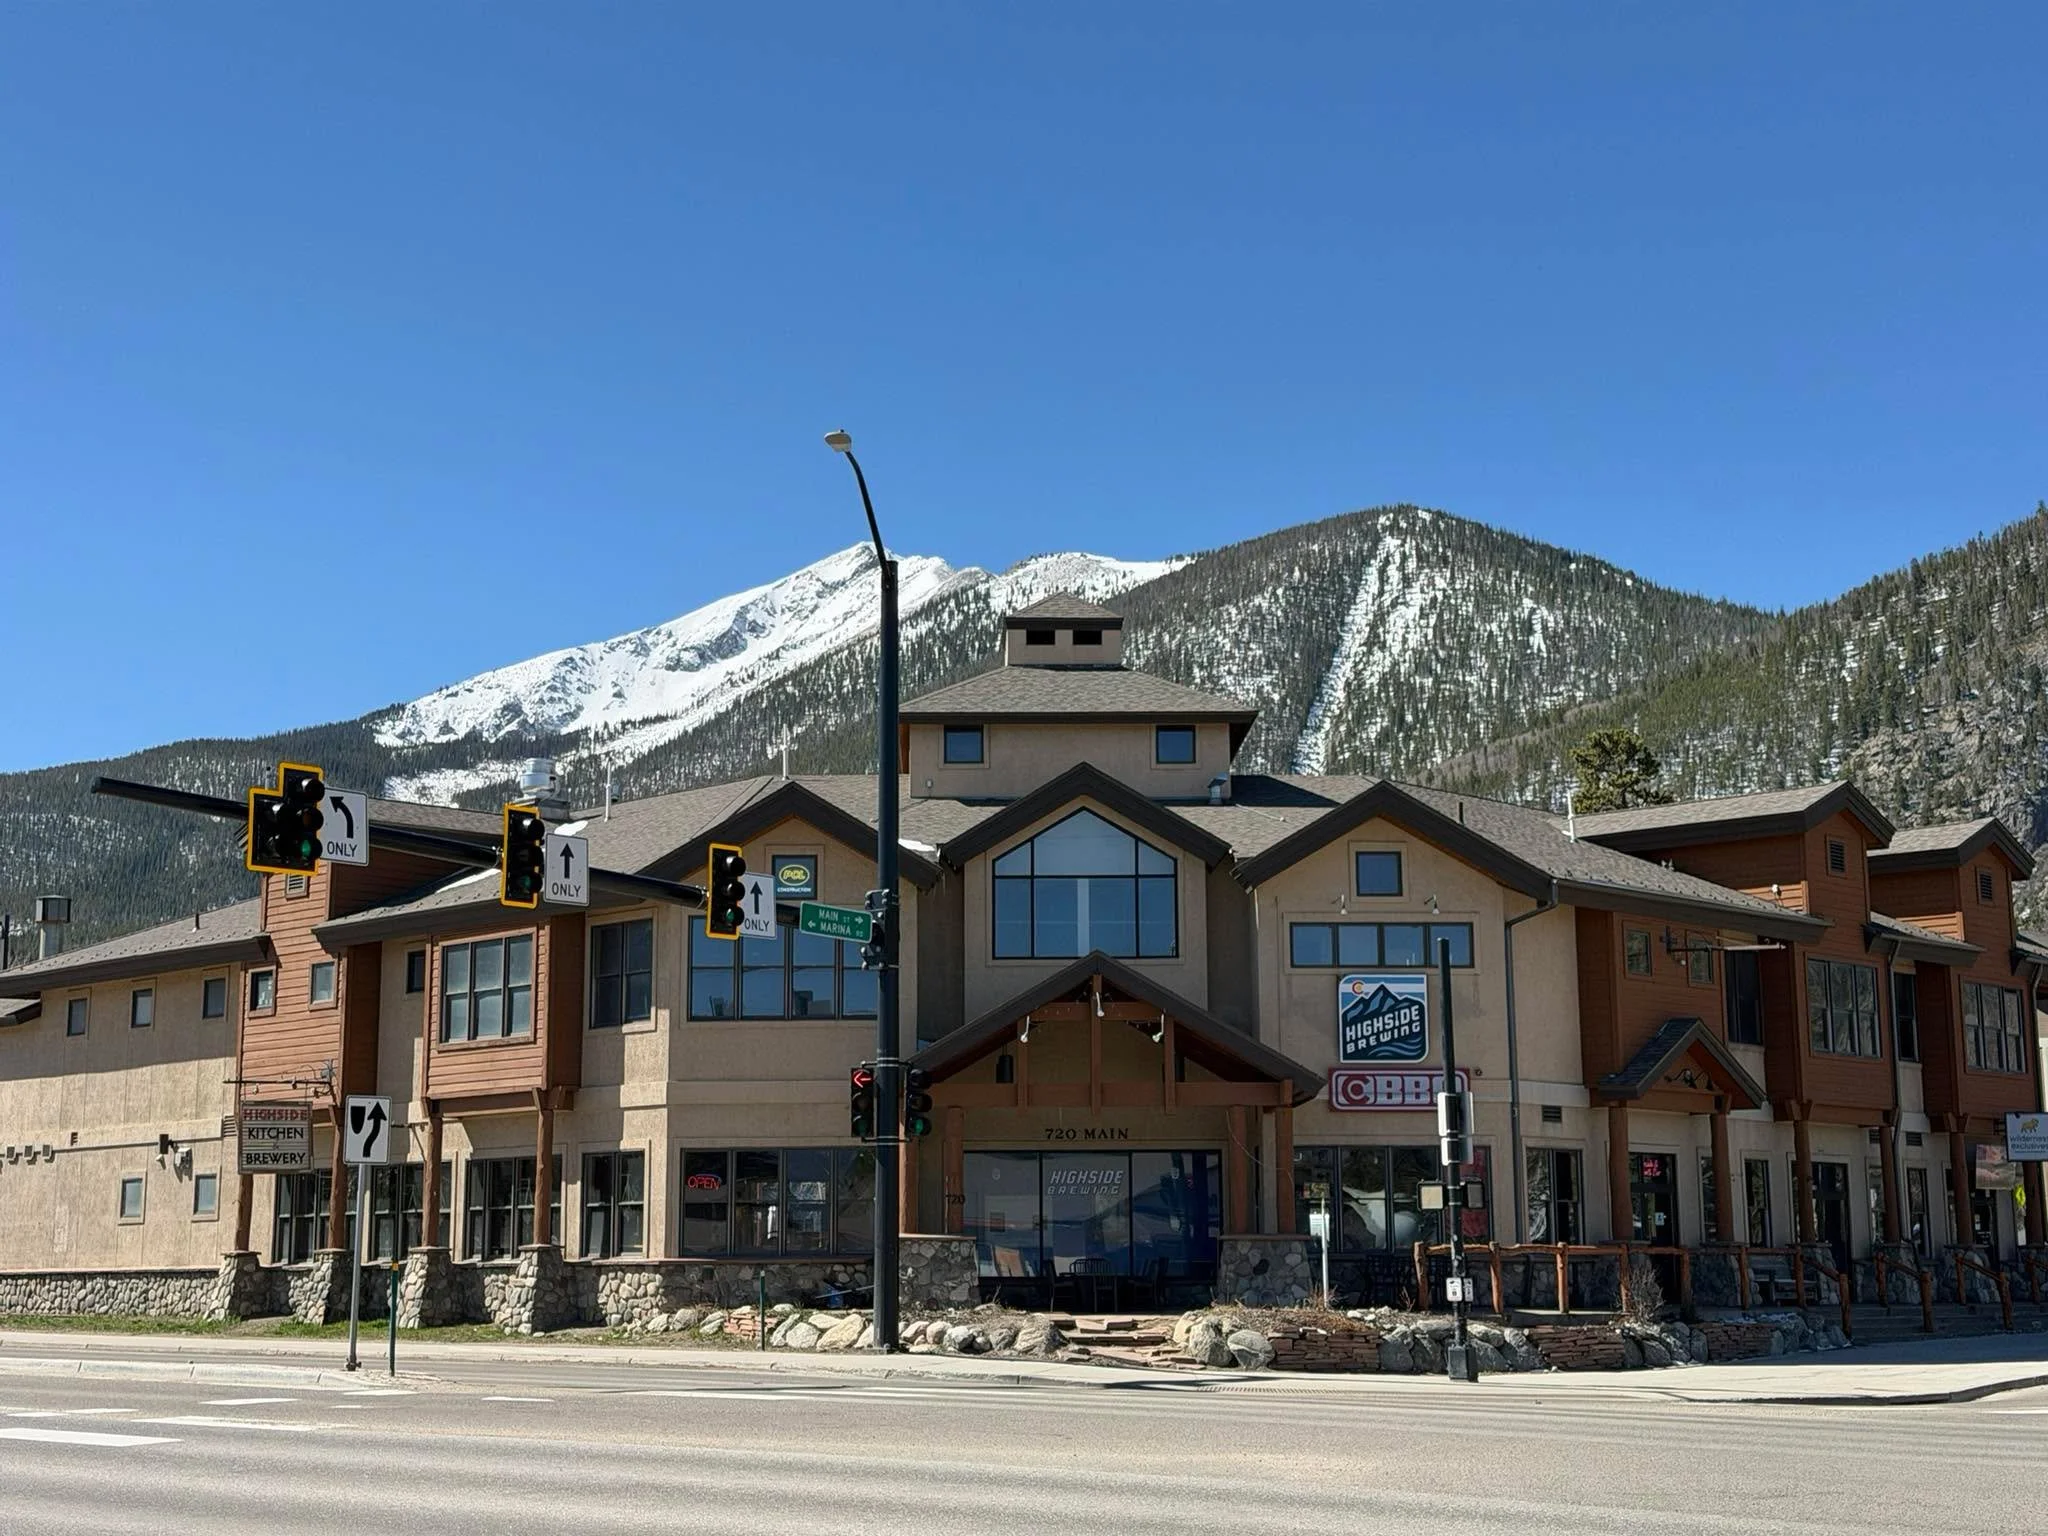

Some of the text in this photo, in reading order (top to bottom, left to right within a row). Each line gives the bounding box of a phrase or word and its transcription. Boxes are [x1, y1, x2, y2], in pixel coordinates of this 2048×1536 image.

[327, 841, 358, 857] ONLY
[551, 882, 581, 897] ONLY
[819, 909, 838, 922] MAIN
[744, 918, 770, 931] ONLY
[820, 921, 852, 936] MARINA
[1346, 1005, 1419, 1042] HIGHSIDE
[1346, 1022, 1420, 1054] BREWING
[243, 1109, 308, 1120] HIGHSIDE
[247, 1127, 304, 1140] KITCHEN
[1046, 1127, 1129, 1140] 720 MAIN
[246, 1152, 306, 1165] BREWERY
[687, 1176, 720, 1190] OPEN
[1050, 1170, 1124, 1184] HIGHSIDE
[1047, 1185, 1119, 1195] BREWING
